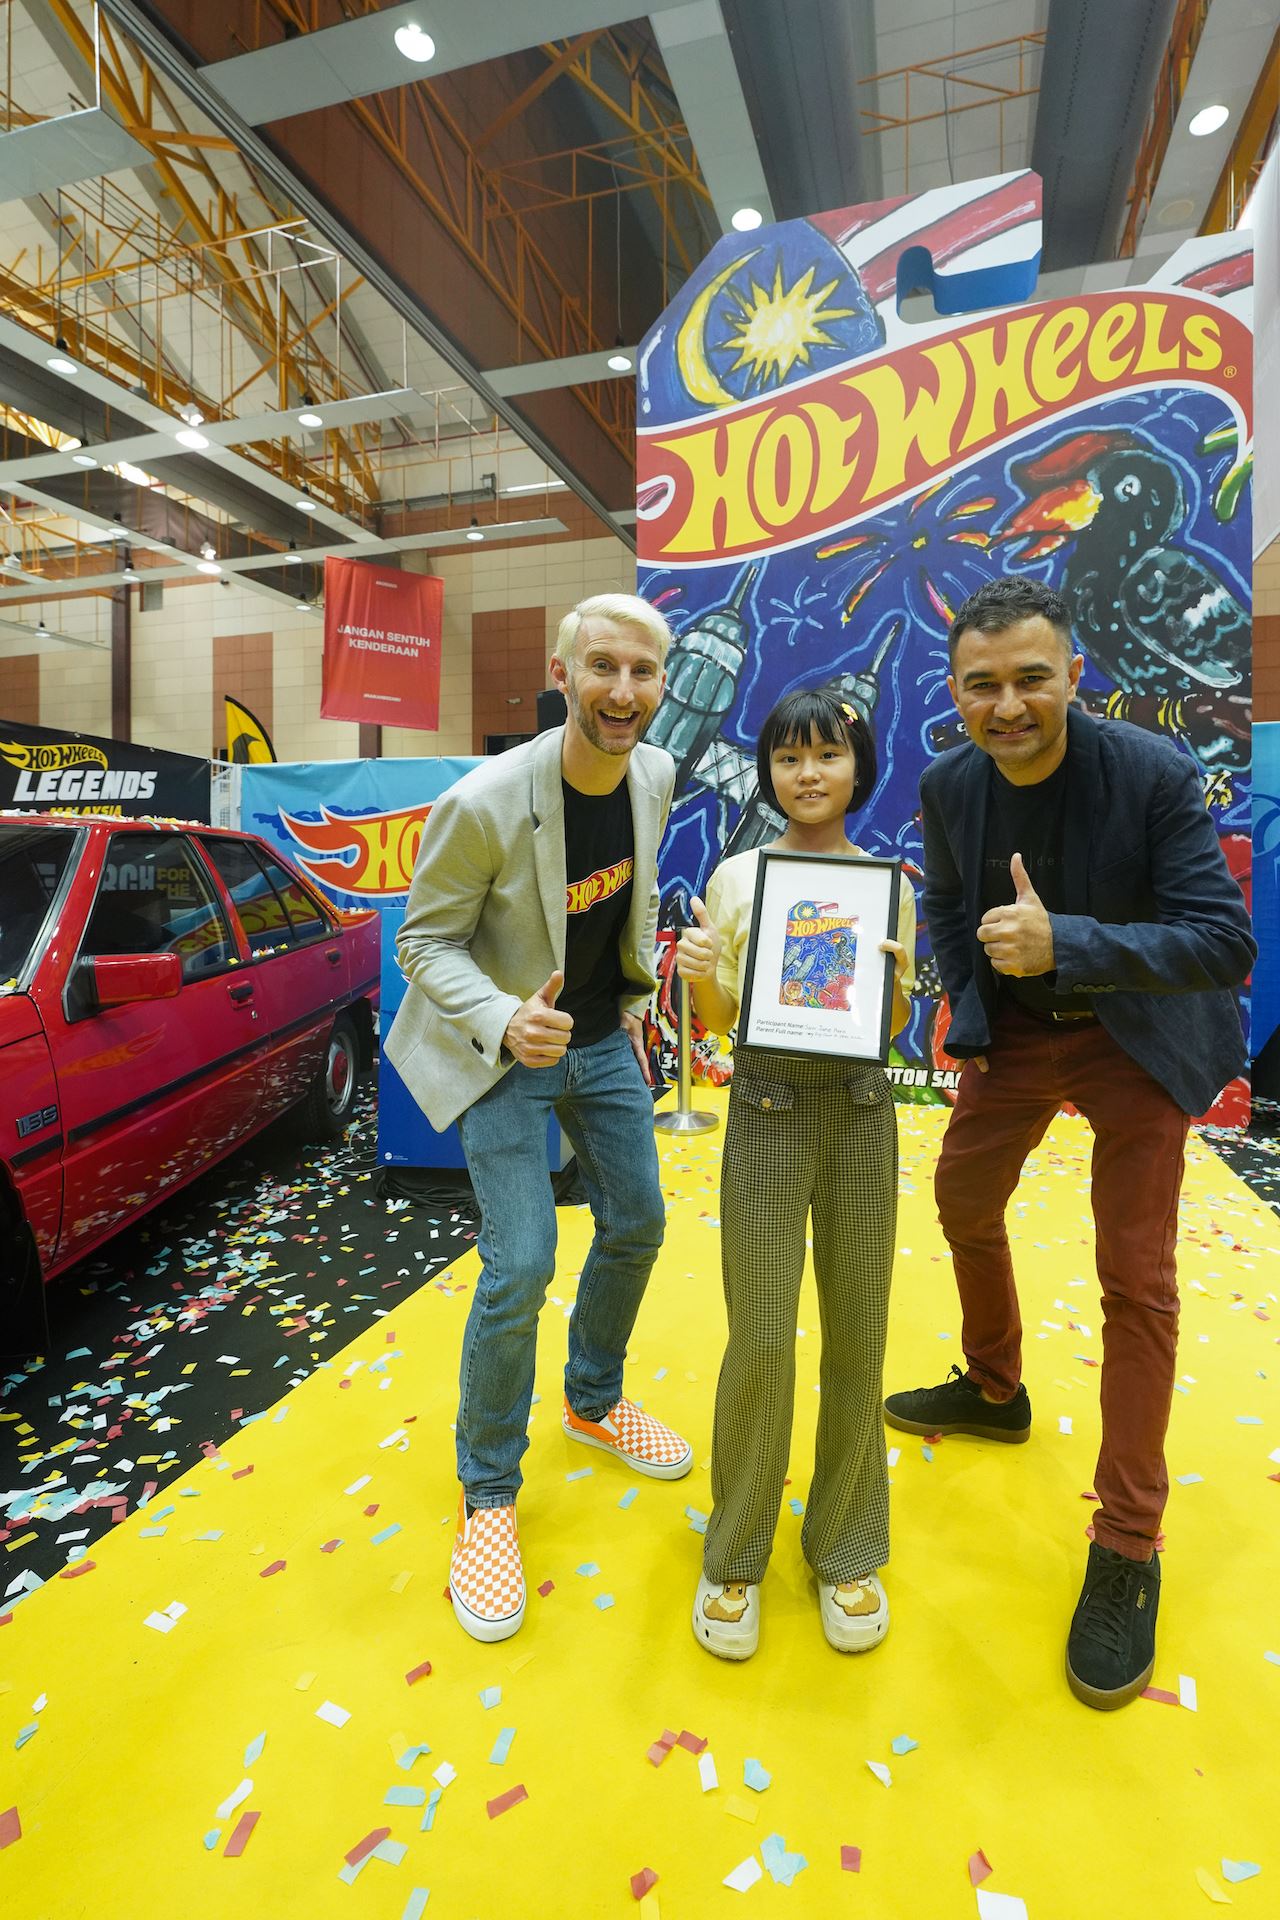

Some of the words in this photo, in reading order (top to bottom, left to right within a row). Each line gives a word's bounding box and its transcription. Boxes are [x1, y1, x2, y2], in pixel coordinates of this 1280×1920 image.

[337, 624, 385, 640] JANGAN
[386, 631, 431, 648] SENTUH
[349, 637, 419, 658] KENDERAAN
[13, 770, 158, 802] LEGENDS
[349, 815, 428, 890] HO
[156, 868, 191, 882] FOR
[156, 883, 190, 897] THE
[755, 1026, 775, 1034] Parent
[756, 1019, 786, 1029] Participant
